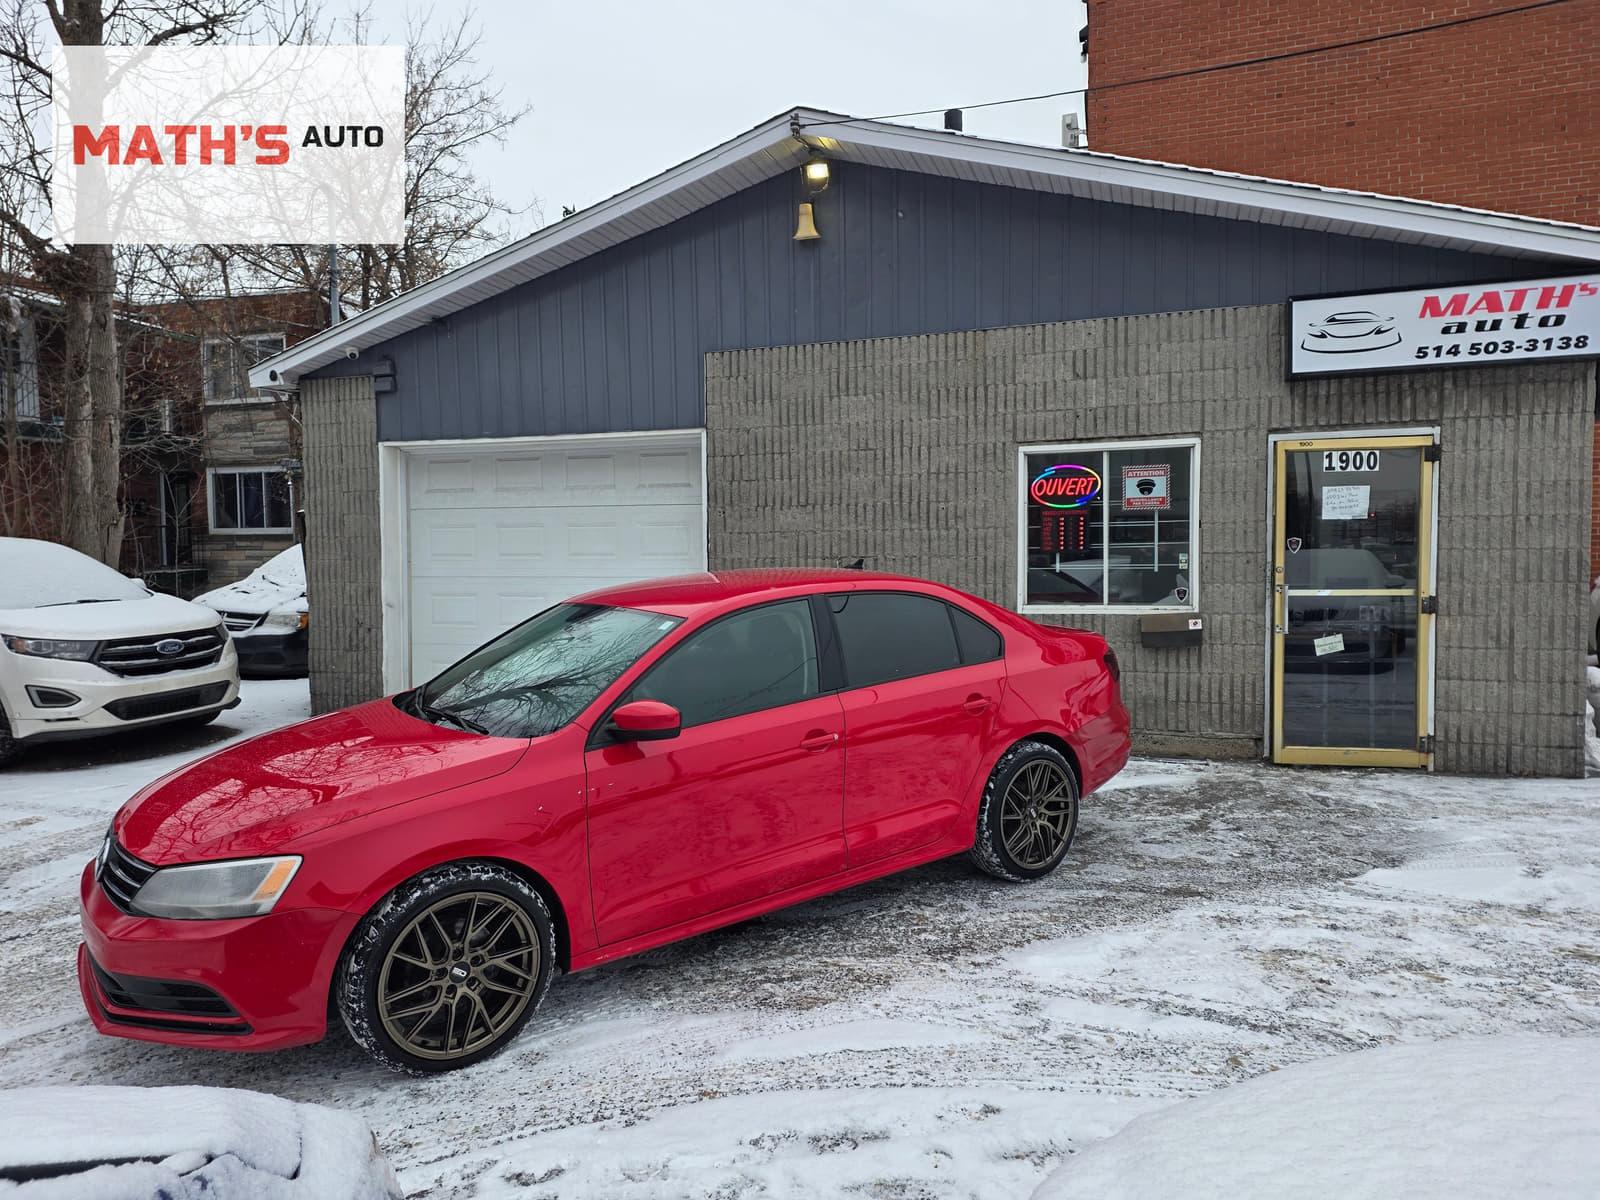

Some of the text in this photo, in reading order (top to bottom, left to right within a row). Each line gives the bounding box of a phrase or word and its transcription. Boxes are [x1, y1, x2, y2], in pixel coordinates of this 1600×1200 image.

[1415, 335, 1589, 359] 514 503-3138
[1325, 451, 1378, 471] 1900
[1035, 477, 1096, 496] OUVERT
